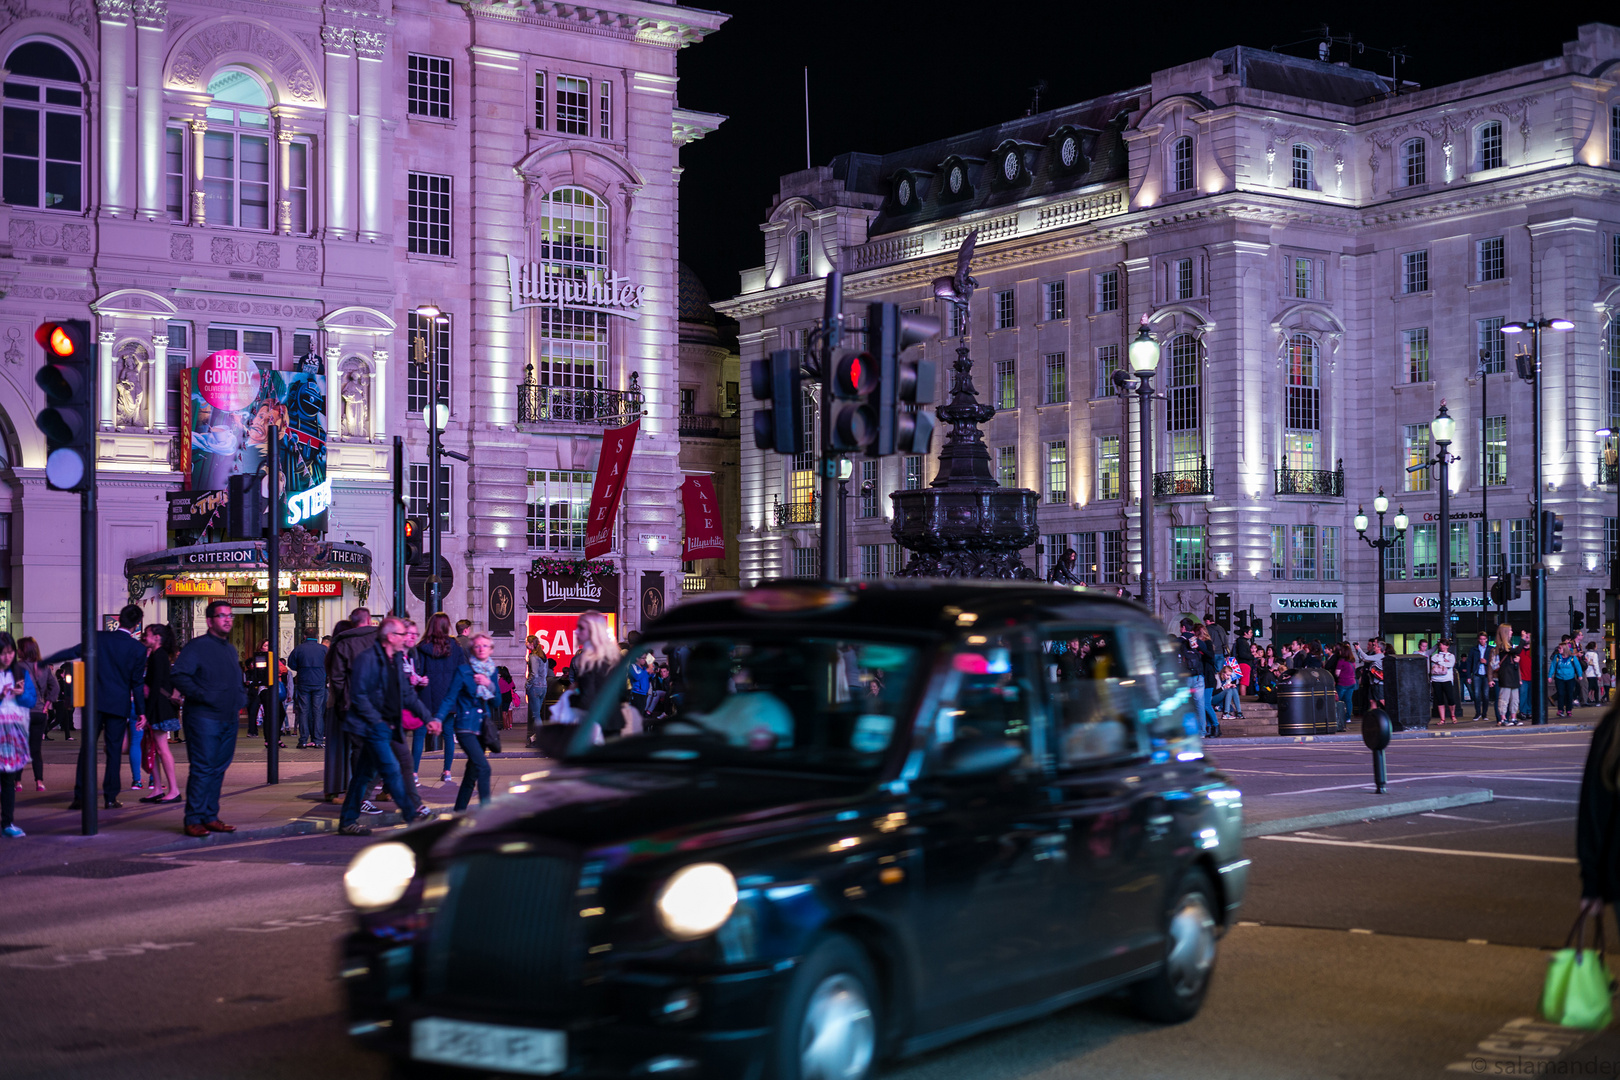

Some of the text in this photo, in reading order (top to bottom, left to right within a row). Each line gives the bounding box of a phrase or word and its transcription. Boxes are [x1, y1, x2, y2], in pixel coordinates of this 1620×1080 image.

[506, 253, 646, 319] Lillywhites
[215, 355, 243, 369] BEST
[204, 370, 253, 385] COMEDY
[183, 426, 190, 449] 39
[596, 438, 624, 521] SALE
[692, 479, 714, 529] SALE
[189, 549, 252, 563] CRITERION
[332, 550, 364, 564] THEATRE
[176, 582, 192, 592] FINAL
[308, 584, 319, 593] END
[320, 584, 324, 593] 5
[324, 584, 336, 593] SEP
[541, 577, 603, 603] Lillywhites
[1288, 598, 1338, 608] Yorkshire Bank
